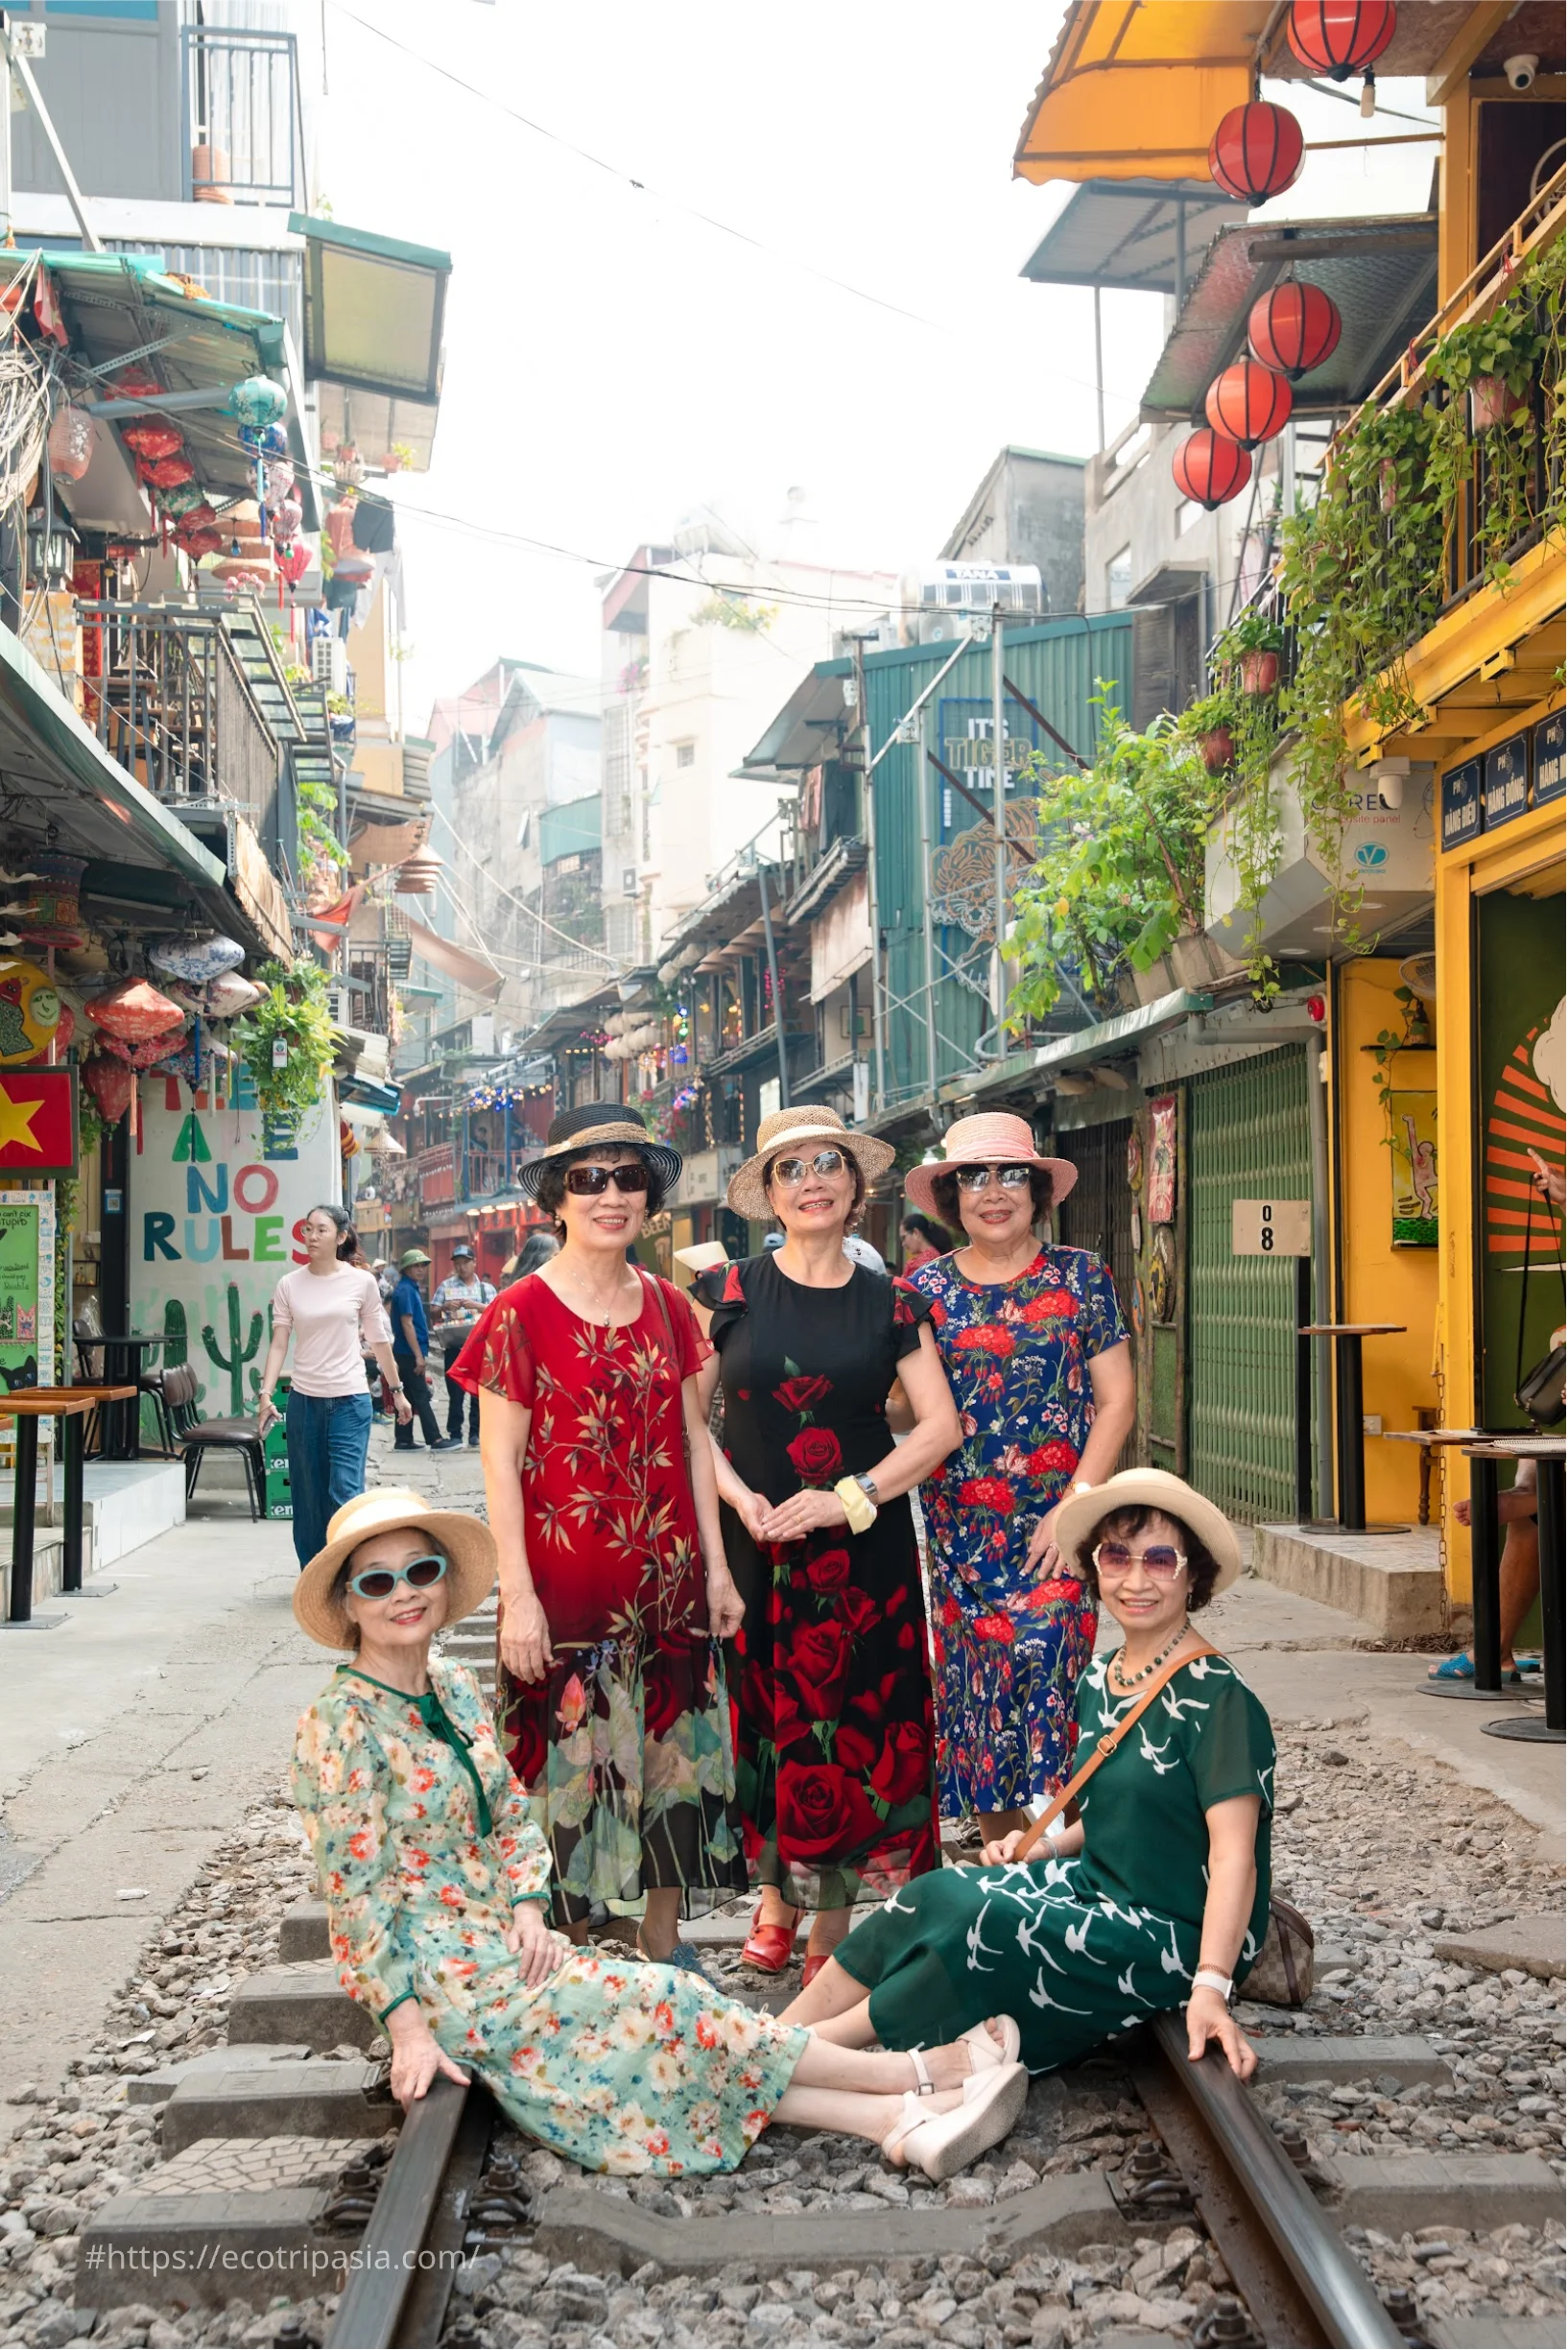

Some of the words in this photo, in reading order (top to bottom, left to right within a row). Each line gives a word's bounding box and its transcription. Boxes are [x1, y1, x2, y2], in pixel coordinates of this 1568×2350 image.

[943, 737, 1033, 771] TIGER
[1539, 758, 1559, 790] HÀNG
[1487, 786, 1505, 816] HÀNG
[1372, 814, 1401, 824] panel
[1444, 808, 1461, 837] HÀNG
[186, 1162, 279, 1214] NO
